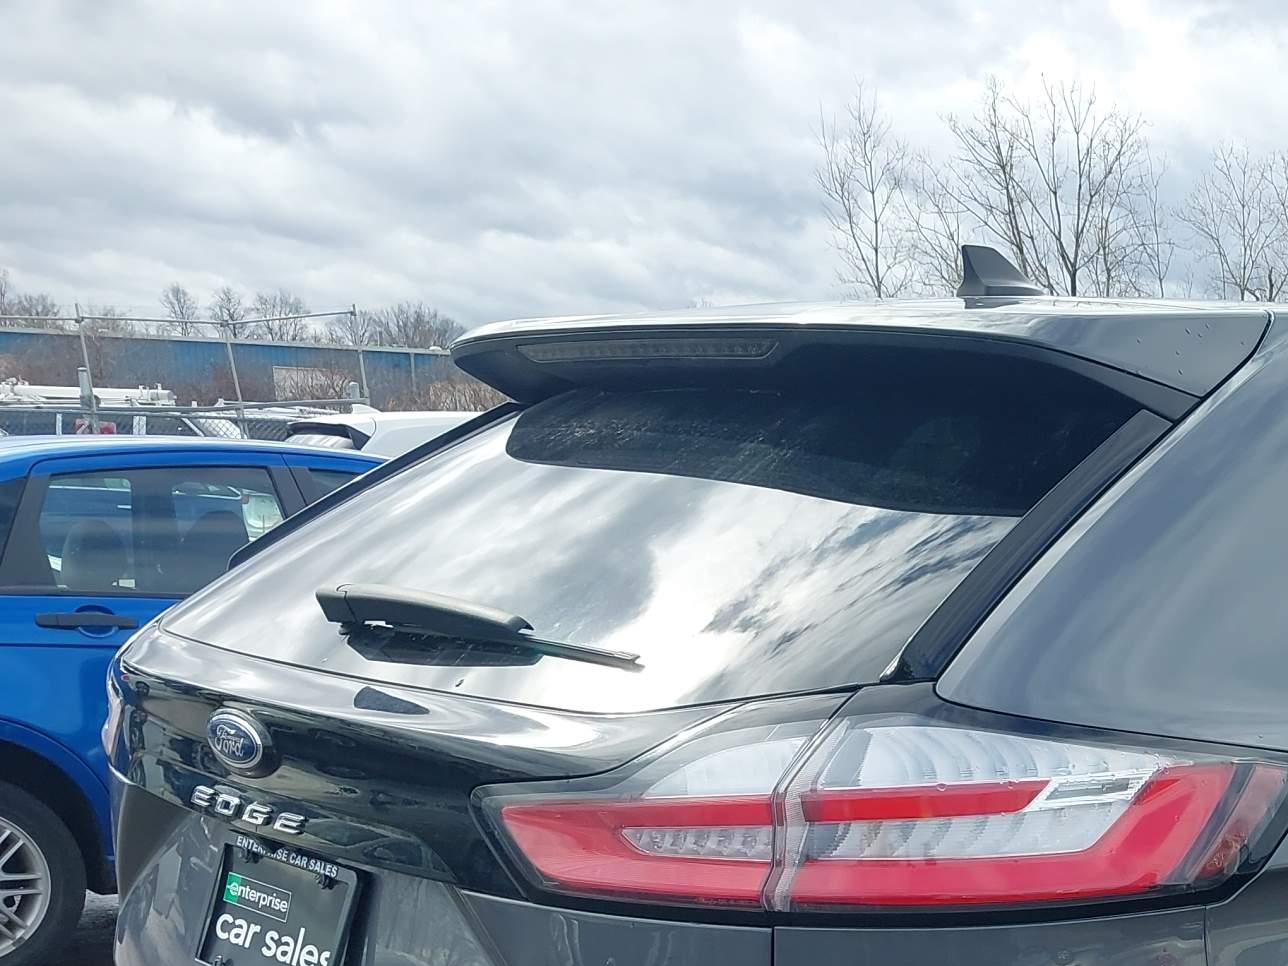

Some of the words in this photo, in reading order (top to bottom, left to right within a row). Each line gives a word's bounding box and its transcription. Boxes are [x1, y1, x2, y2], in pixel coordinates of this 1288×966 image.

[215, 725, 245, 757] Ford
[191, 785, 306, 834] EDGE
[289, 853, 308, 868] CAR
[308, 859, 338, 878] SALES
[227, 881, 288, 912] enterprise
[215, 913, 261, 949] car
